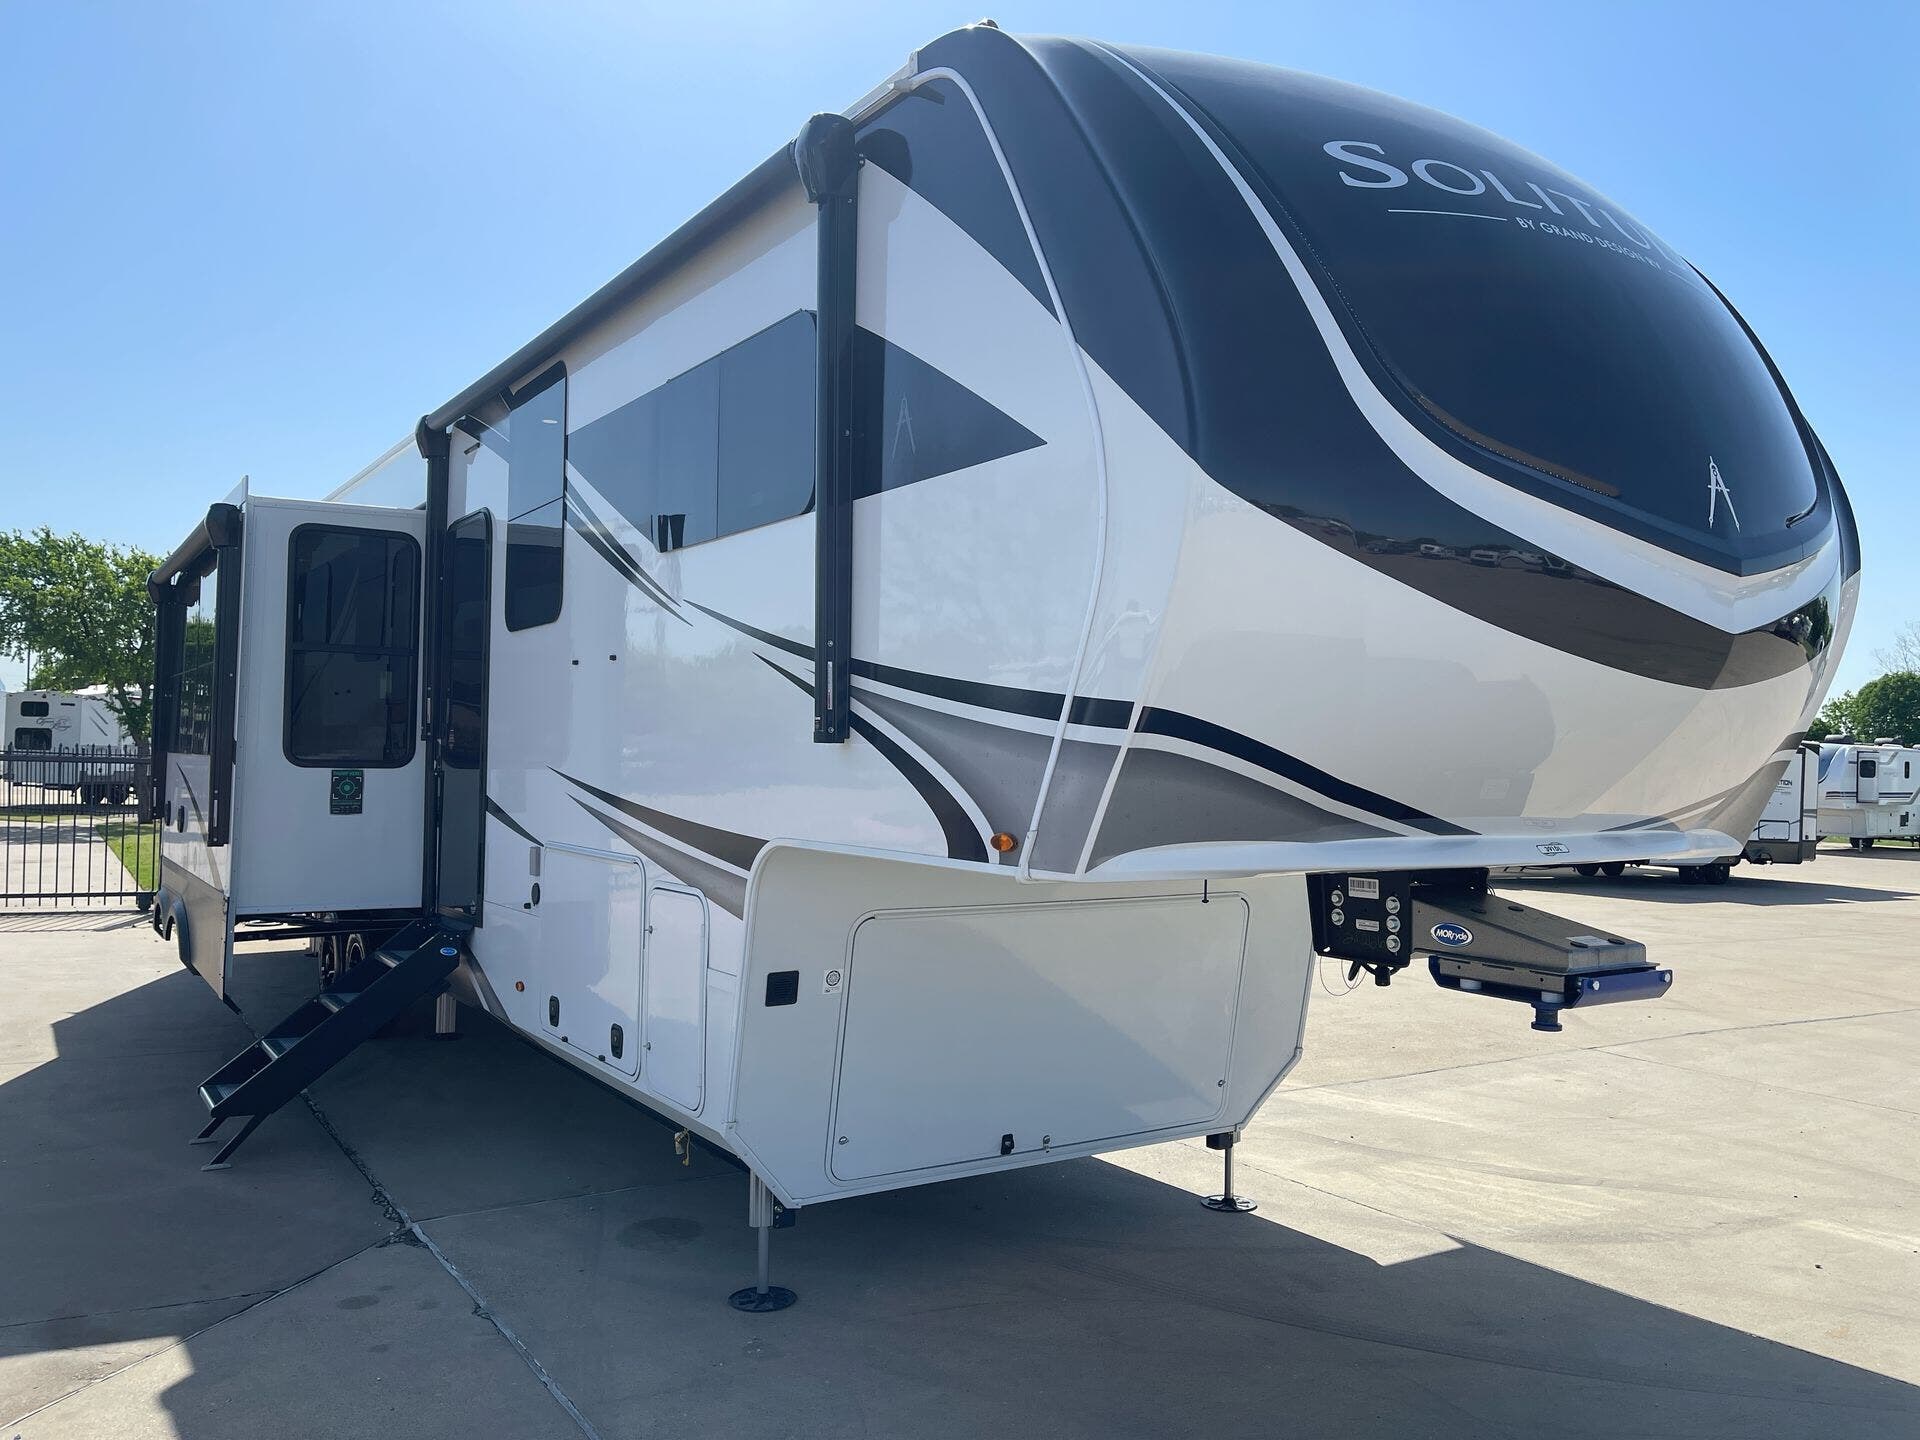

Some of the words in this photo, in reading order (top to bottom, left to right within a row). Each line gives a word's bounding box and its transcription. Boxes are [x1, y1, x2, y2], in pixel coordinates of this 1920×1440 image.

[1515, 217, 1535, 230] BY
[1540, 222, 1593, 244] GRAND
[1594, 236, 1645, 262] DESIGN
